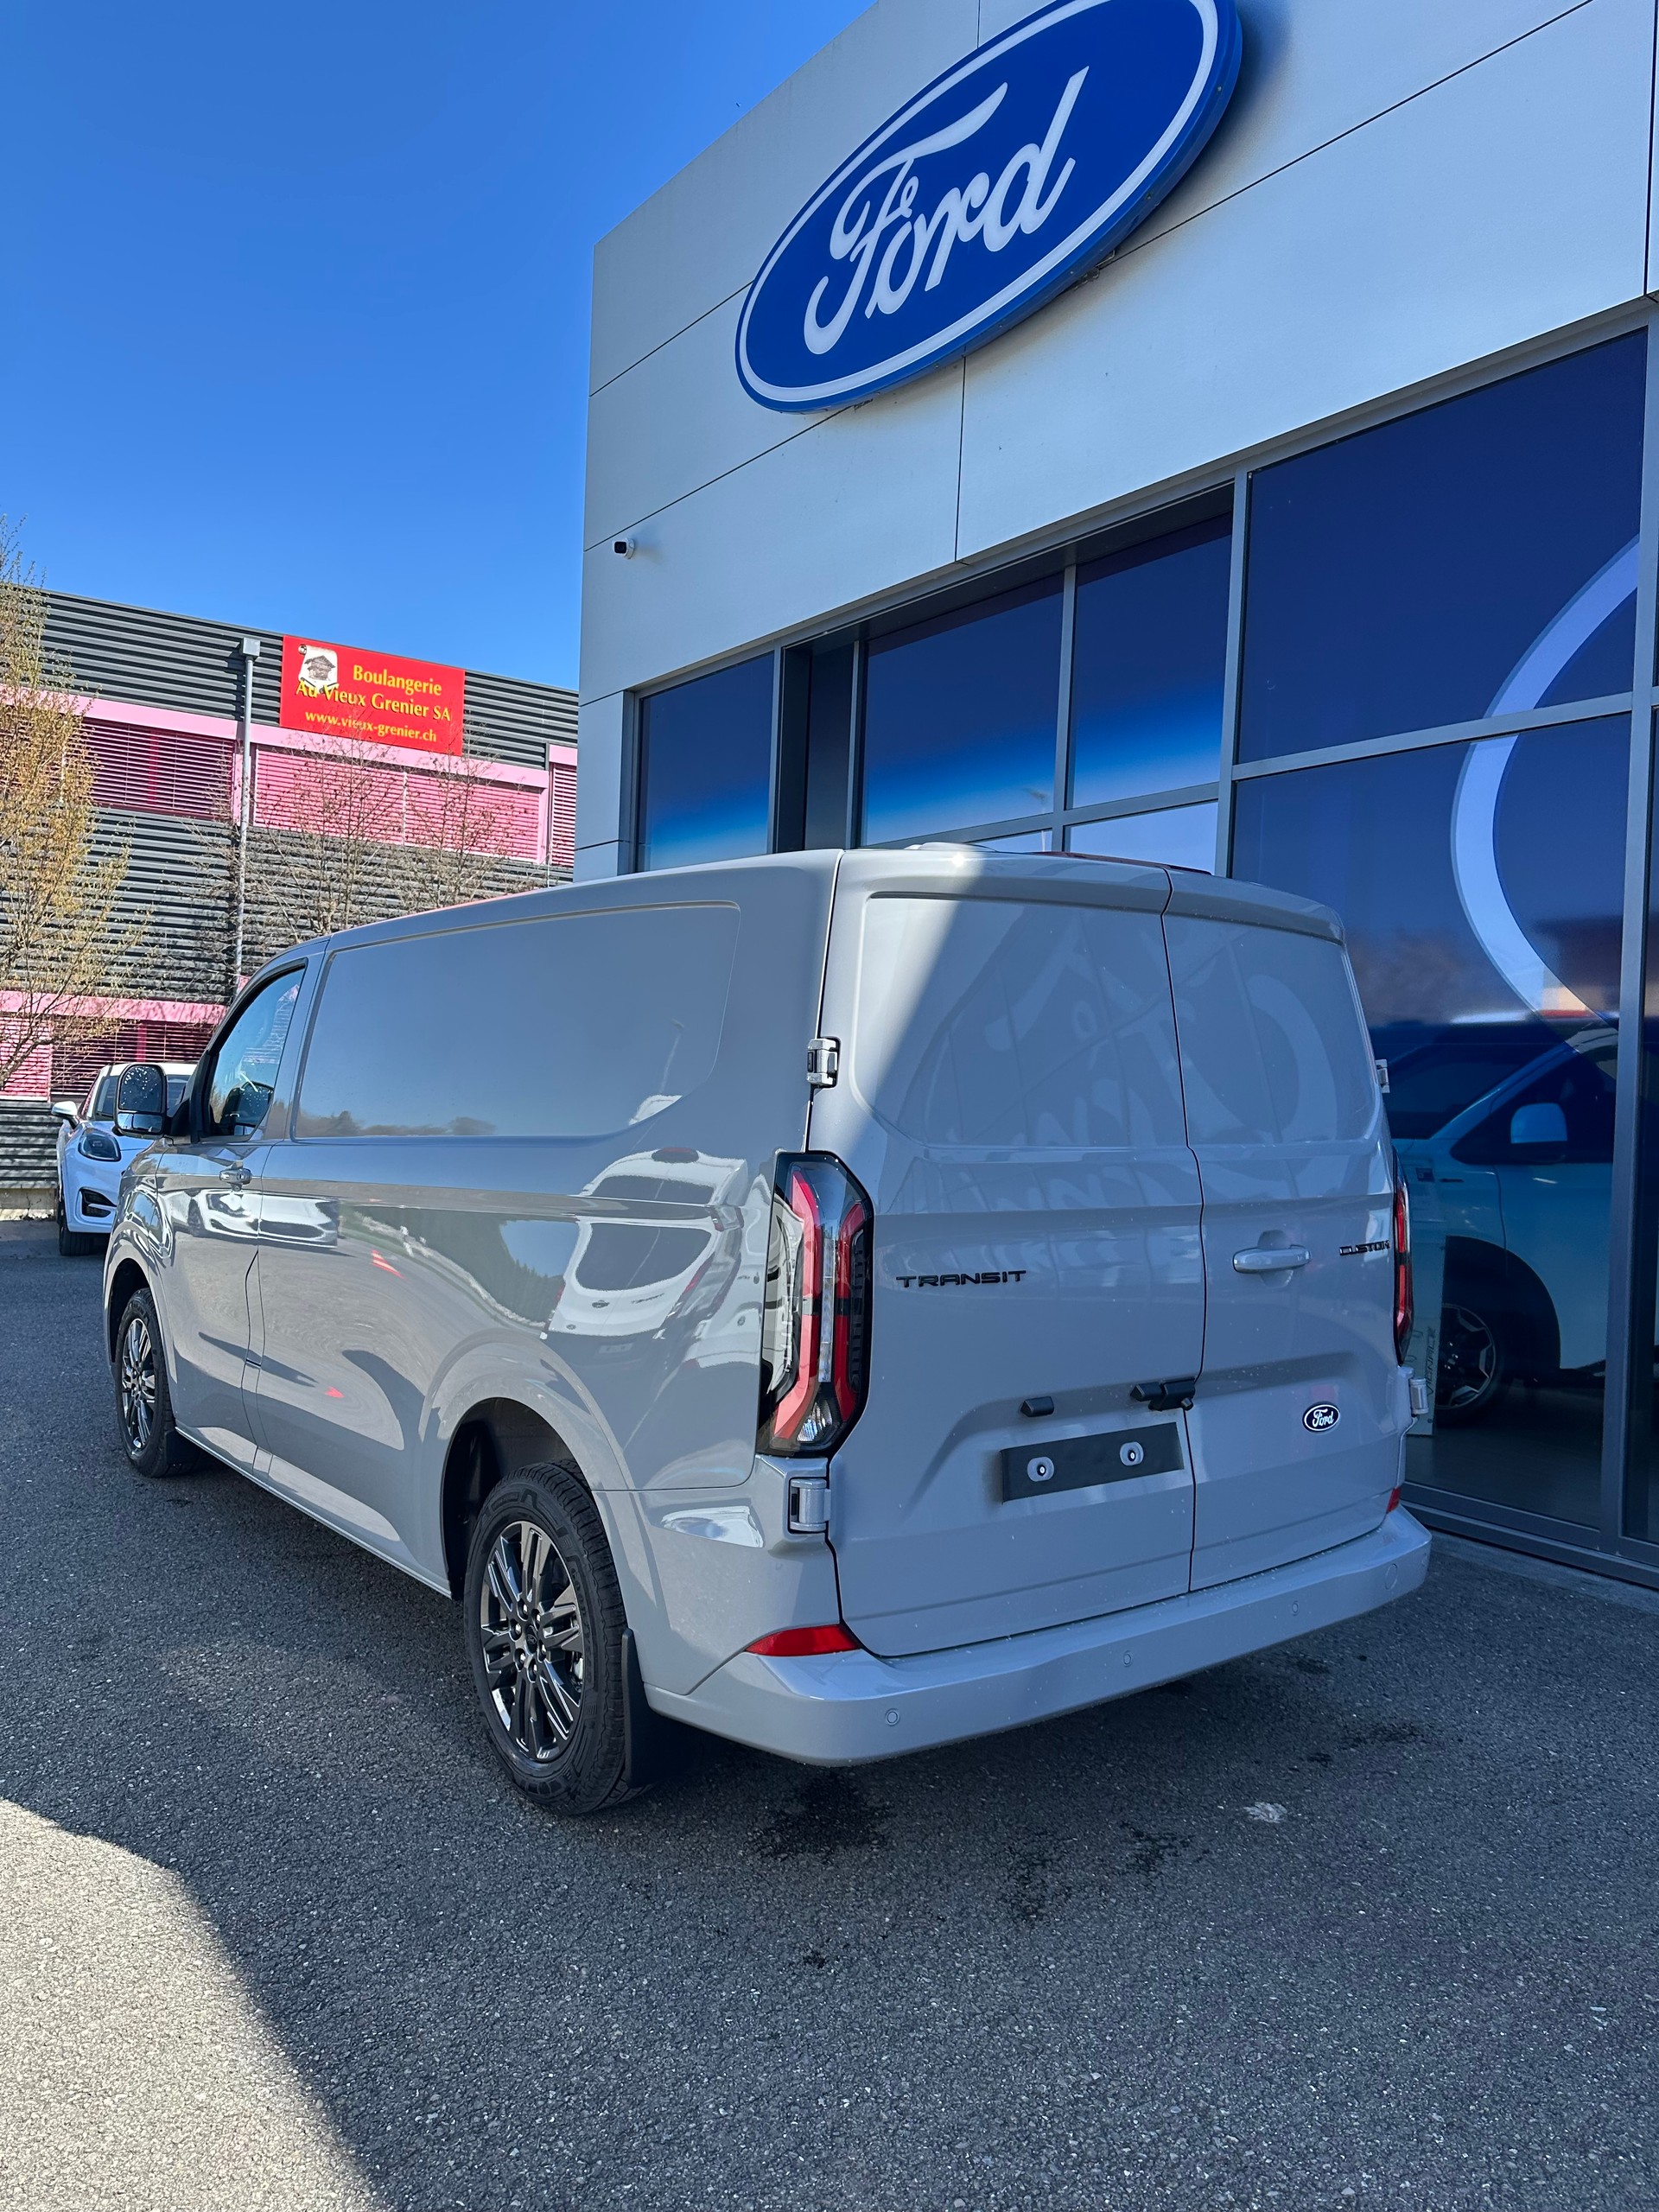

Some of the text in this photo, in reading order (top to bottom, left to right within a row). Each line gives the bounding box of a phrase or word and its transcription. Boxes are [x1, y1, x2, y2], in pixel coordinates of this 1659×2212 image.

[804, 66, 1089, 355] Ford
[353, 664, 442, 696] Boulangerie
[296, 680, 451, 721] Au Vieux Grenier SA
[305, 711, 436, 742] www.vieux-grenier.ch
[896, 1270, 1027, 1287] TRANSIT
[1313, 1408, 1334, 1427] Ford
